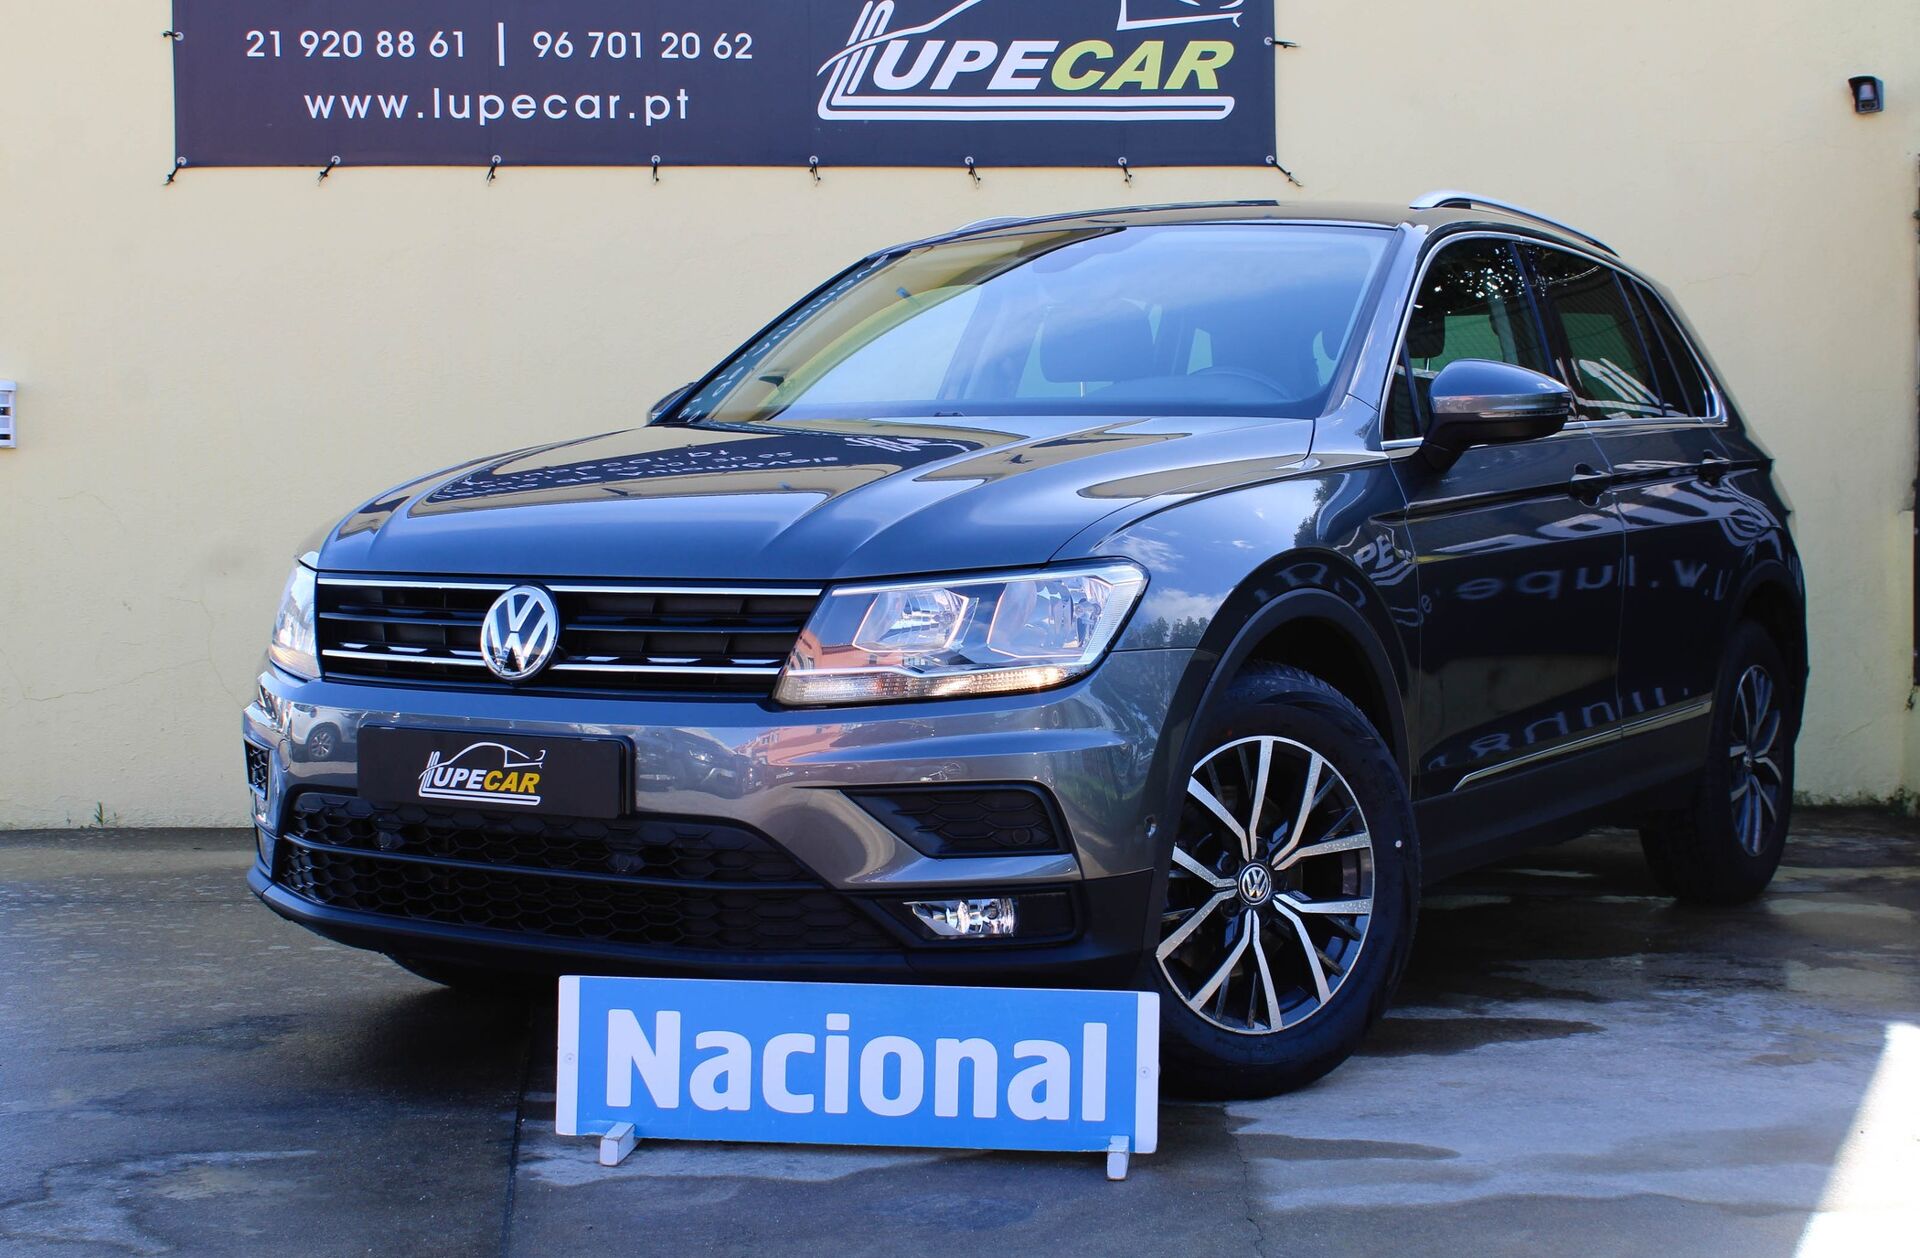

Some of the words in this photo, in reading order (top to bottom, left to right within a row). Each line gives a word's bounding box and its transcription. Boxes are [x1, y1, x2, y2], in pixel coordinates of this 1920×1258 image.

[246, 30, 281, 57] 21
[299, 30, 363, 58] 920
[376, 30, 416, 58] 88
[429, 31, 464, 58] 61
[532, 31, 574, 58] 96
[588, 31, 642, 58] 701
[661, 32, 701, 59] 20
[713, 32, 753, 60] 62
[817, 0, 1235, 120] LUPECAR
[303, 87, 689, 127] www.lupecar.pt
[418, 750, 541, 806] LUPECAR
[605, 1008, 1108, 1122] Nacional
